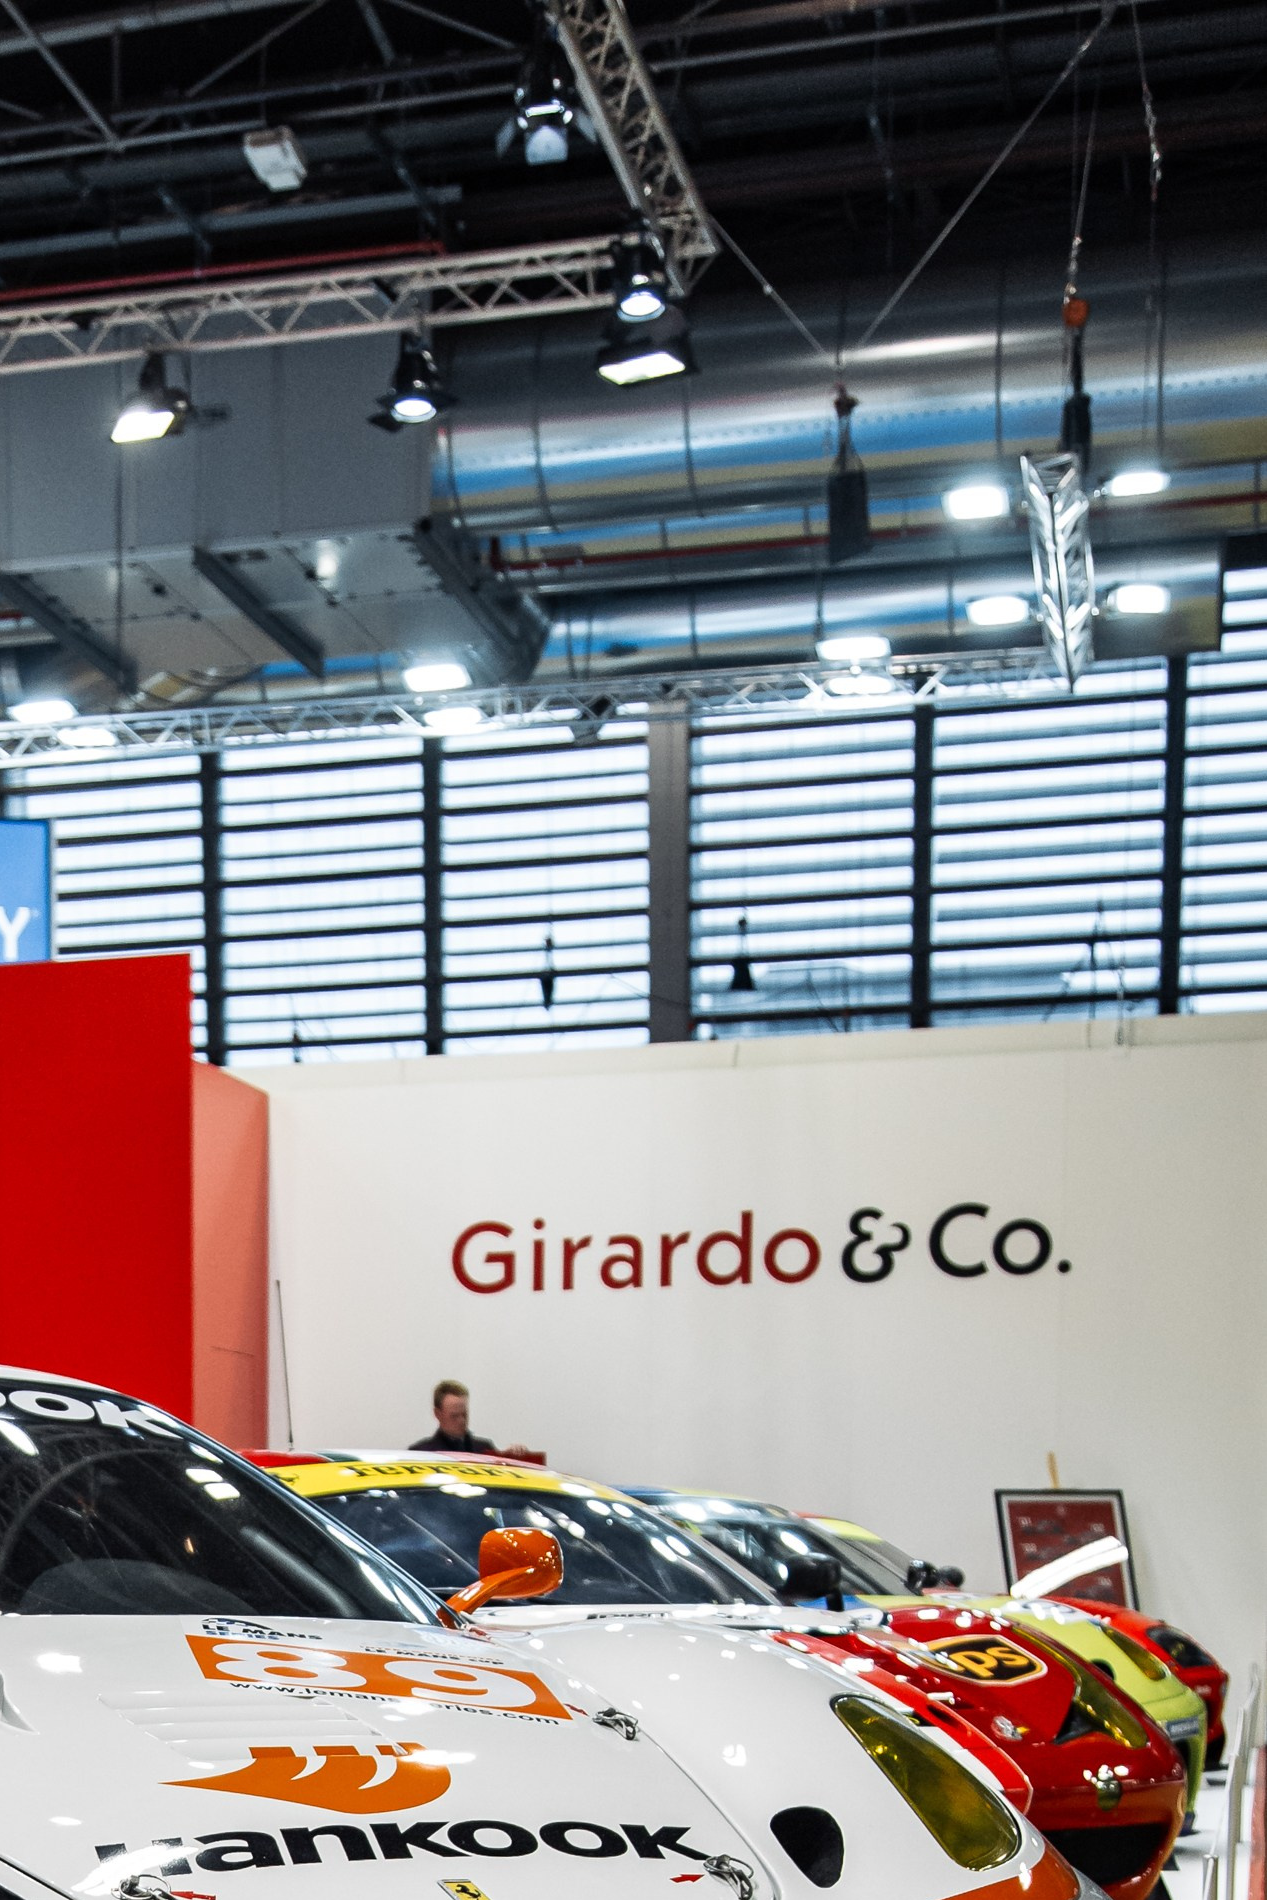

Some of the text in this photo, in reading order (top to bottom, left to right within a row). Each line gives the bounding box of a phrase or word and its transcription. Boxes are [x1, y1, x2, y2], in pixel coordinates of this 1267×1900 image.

[451, 1210, 822, 1294] Girardo
[242, 1628, 323, 1640] MANS
[212, 1643, 537, 1709] 89
